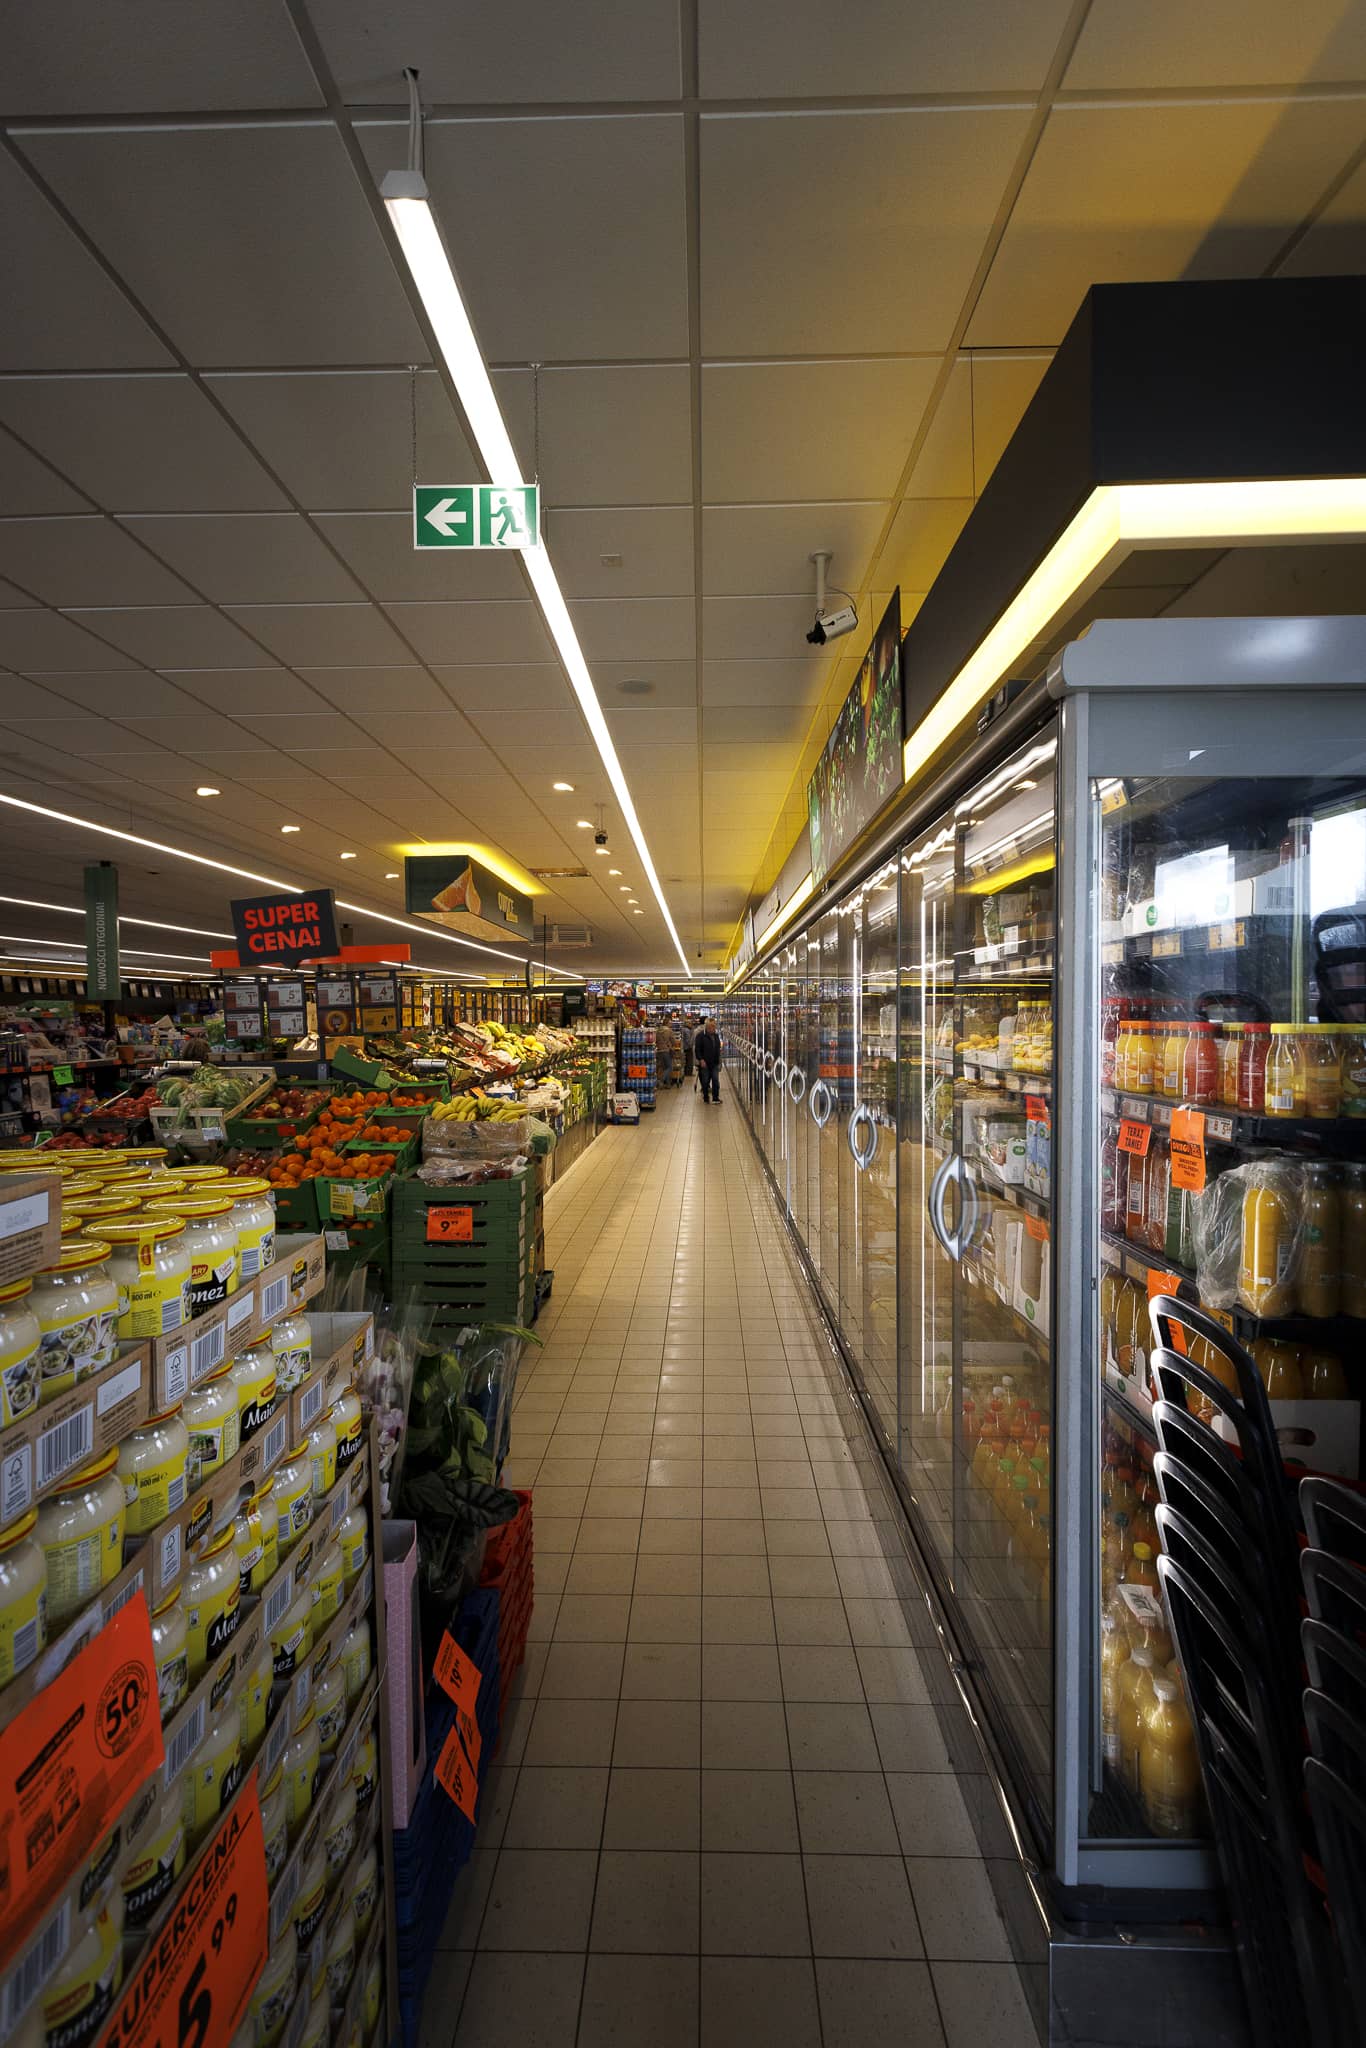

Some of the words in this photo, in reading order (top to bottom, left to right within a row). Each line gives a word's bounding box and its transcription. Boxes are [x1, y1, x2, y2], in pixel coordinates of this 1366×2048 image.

[243, 902, 319, 930] SUPER
[248, 926, 321, 953] CENA!
[106, 1679, 139, 1740] 50
